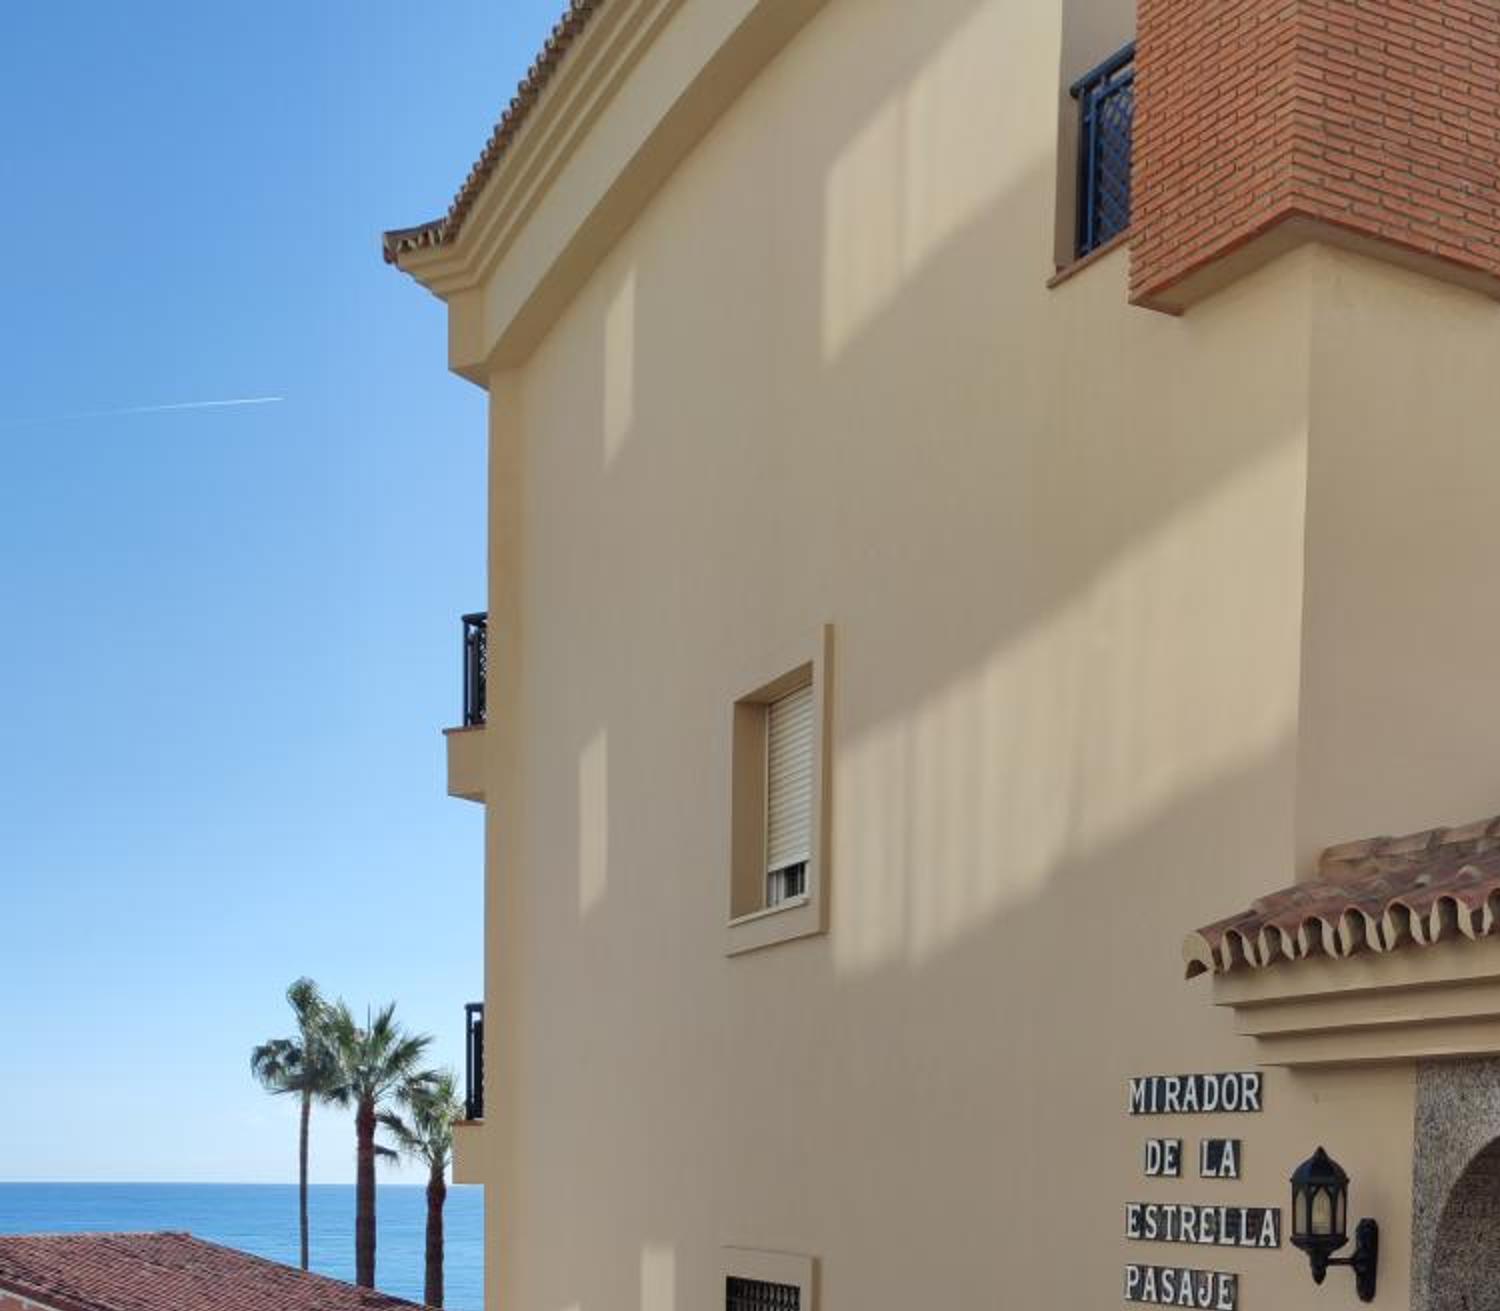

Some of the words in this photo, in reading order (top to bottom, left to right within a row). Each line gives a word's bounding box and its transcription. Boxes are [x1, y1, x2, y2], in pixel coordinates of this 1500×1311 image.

[1128, 1073, 1261, 1113] MIRADOR
[1146, 1140, 1179, 1177] DE
[1202, 1140, 1238, 1177] LA
[1127, 1204, 1278, 1247] ESTRELLA
[1125, 1265, 1235, 1311] PASAJE
